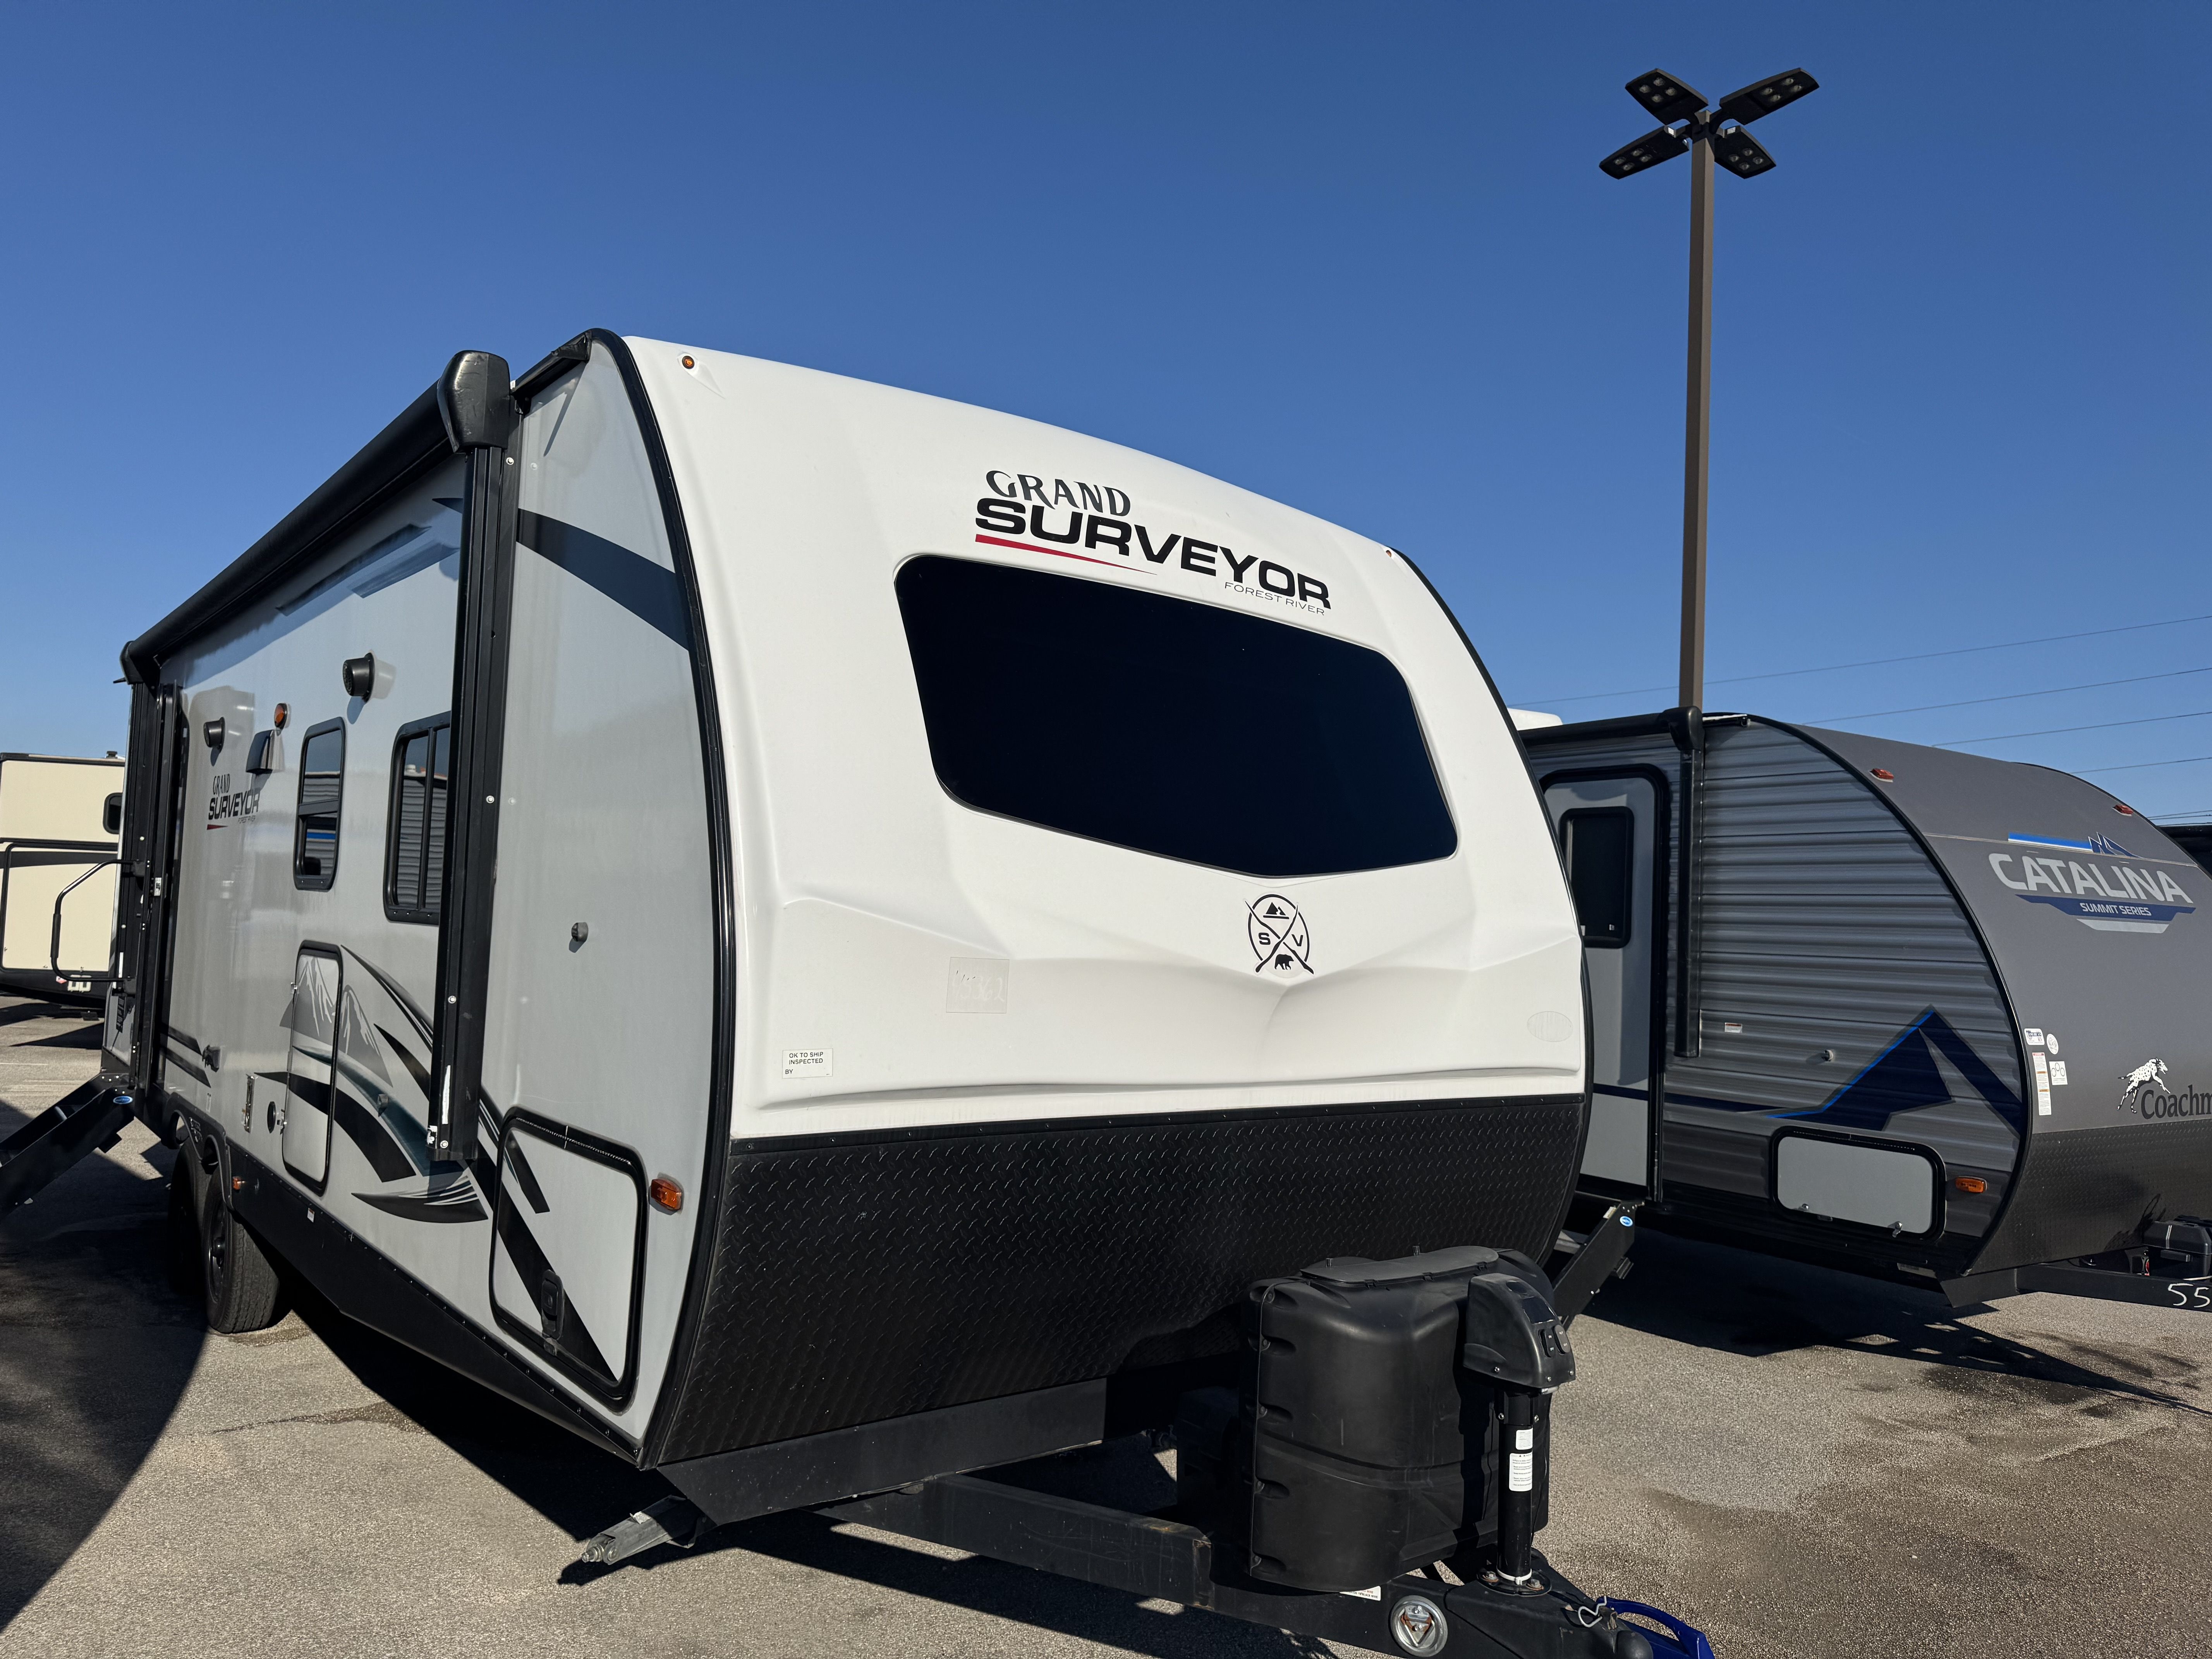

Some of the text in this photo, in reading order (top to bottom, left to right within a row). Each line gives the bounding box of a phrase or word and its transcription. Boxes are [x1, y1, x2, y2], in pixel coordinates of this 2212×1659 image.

[986, 470, 1131, 517] GRAND
[975, 498, 1331, 610] SURVEYOR
[1224, 582, 1325, 616] FOREST RIVER
[213, 773, 230, 796] GRAND
[208, 788, 261, 820] SURVEYOR
[1989, 853, 2194, 904] CATALINA
[2080, 902, 2152, 916] SUMMIT SERIES
[1258, 932, 1304, 946] S V
